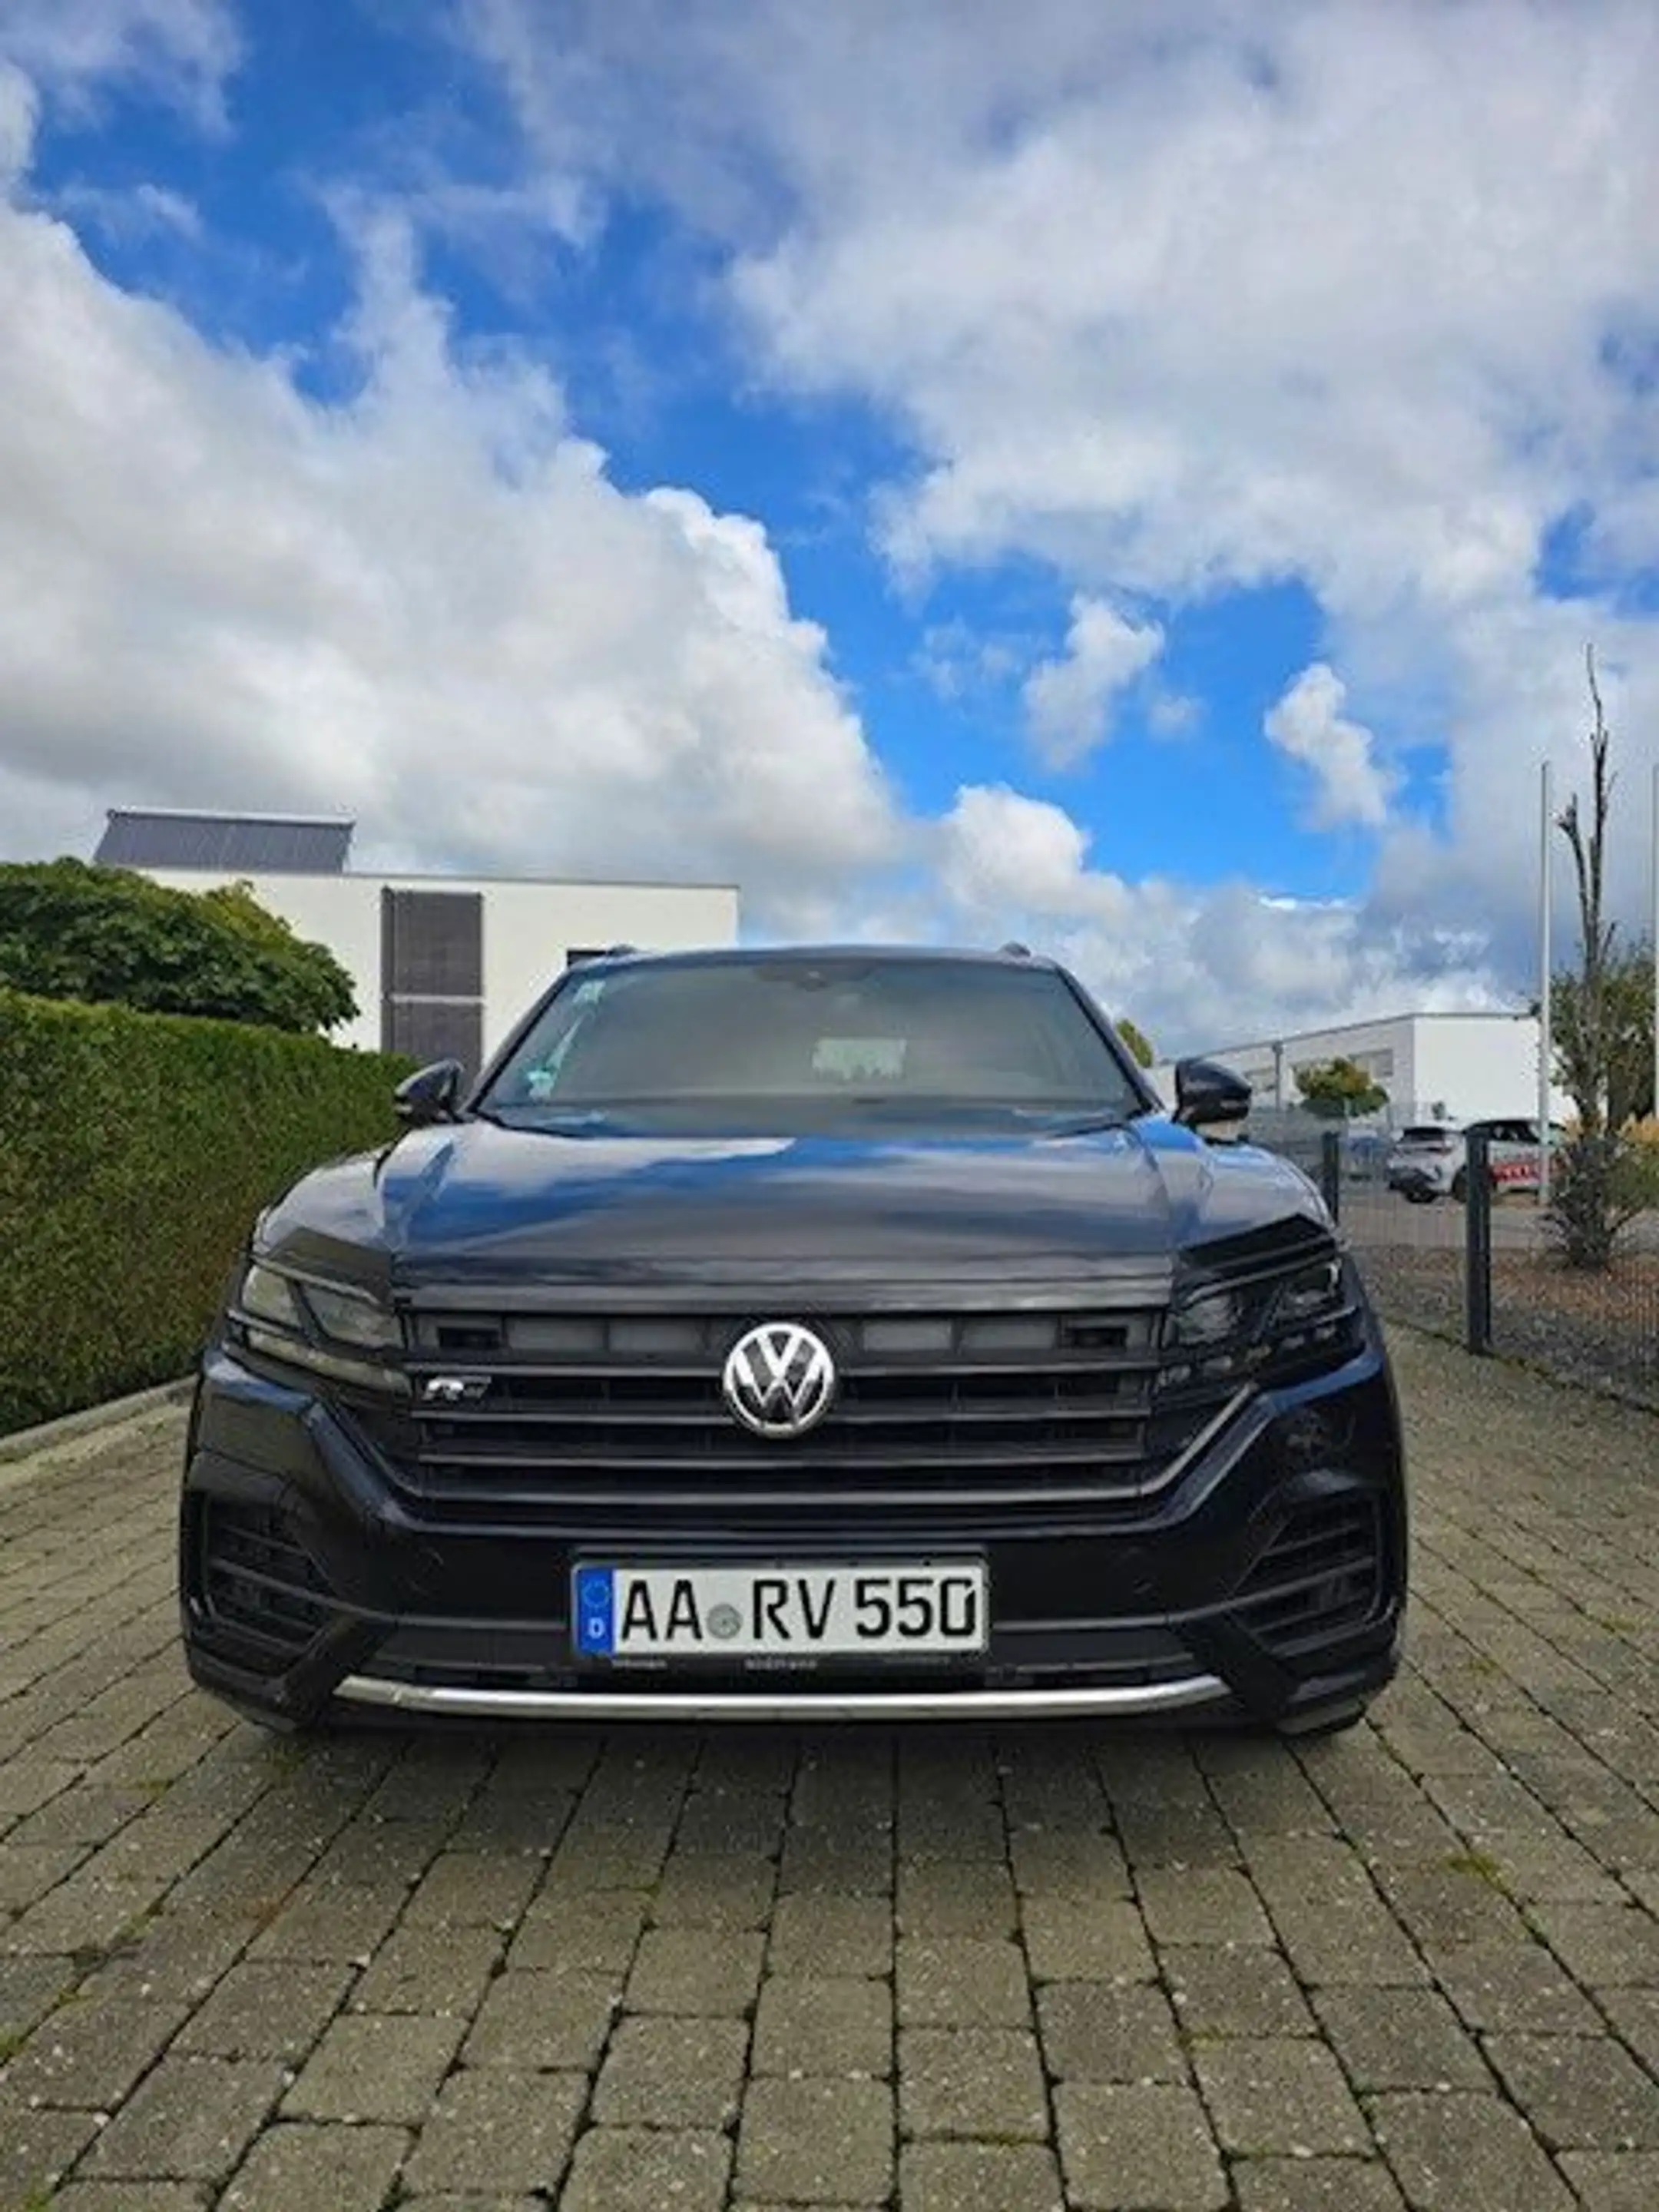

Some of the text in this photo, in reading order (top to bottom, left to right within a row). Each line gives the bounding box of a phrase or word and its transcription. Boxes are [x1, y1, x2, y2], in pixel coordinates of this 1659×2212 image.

[621, 1578, 975, 1640] AA RV 550
